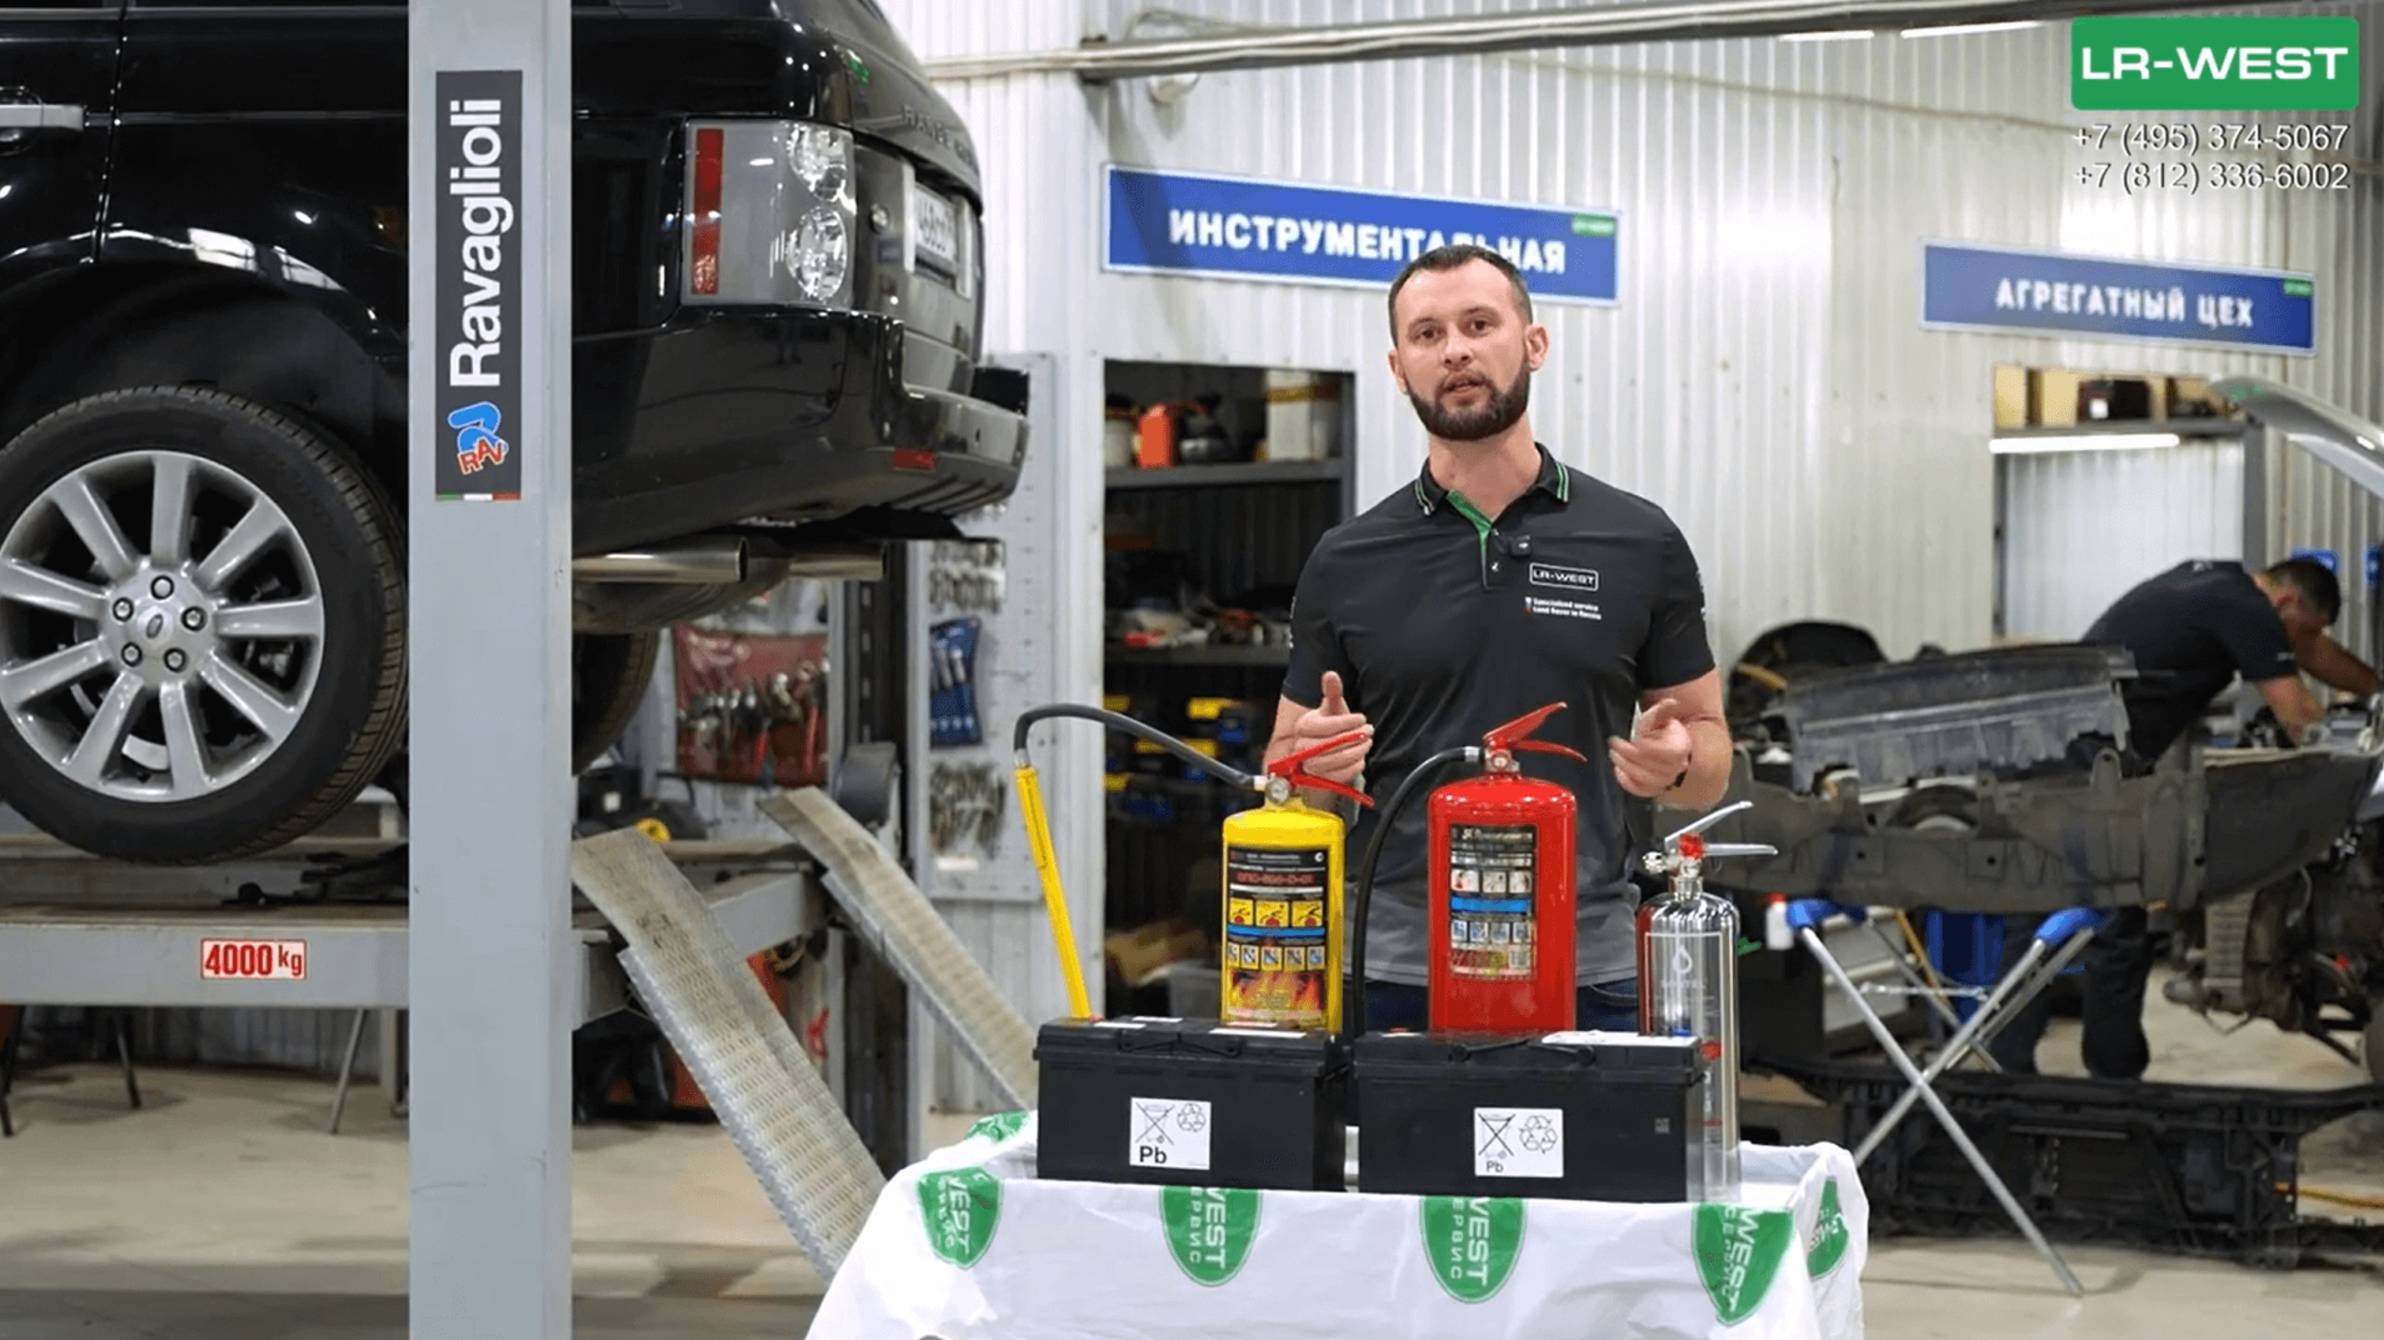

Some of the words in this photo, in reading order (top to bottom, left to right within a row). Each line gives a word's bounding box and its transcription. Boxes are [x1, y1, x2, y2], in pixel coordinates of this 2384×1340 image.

[449, 99, 514, 387] Ravaglioli
[1996, 277, 2186, 323] АГРЕГАТНЫЙ
[2197, 293, 2254, 330] ЦЕХ
[457, 436, 507, 475] RAV
[1533, 569, 1595, 585] LR-WEST
[205, 943, 273, 976] 4000
[277, 943, 303, 977] kg
[1139, 1145, 1168, 1164] Pb
[1485, 1160, 1504, 1174] Pb
